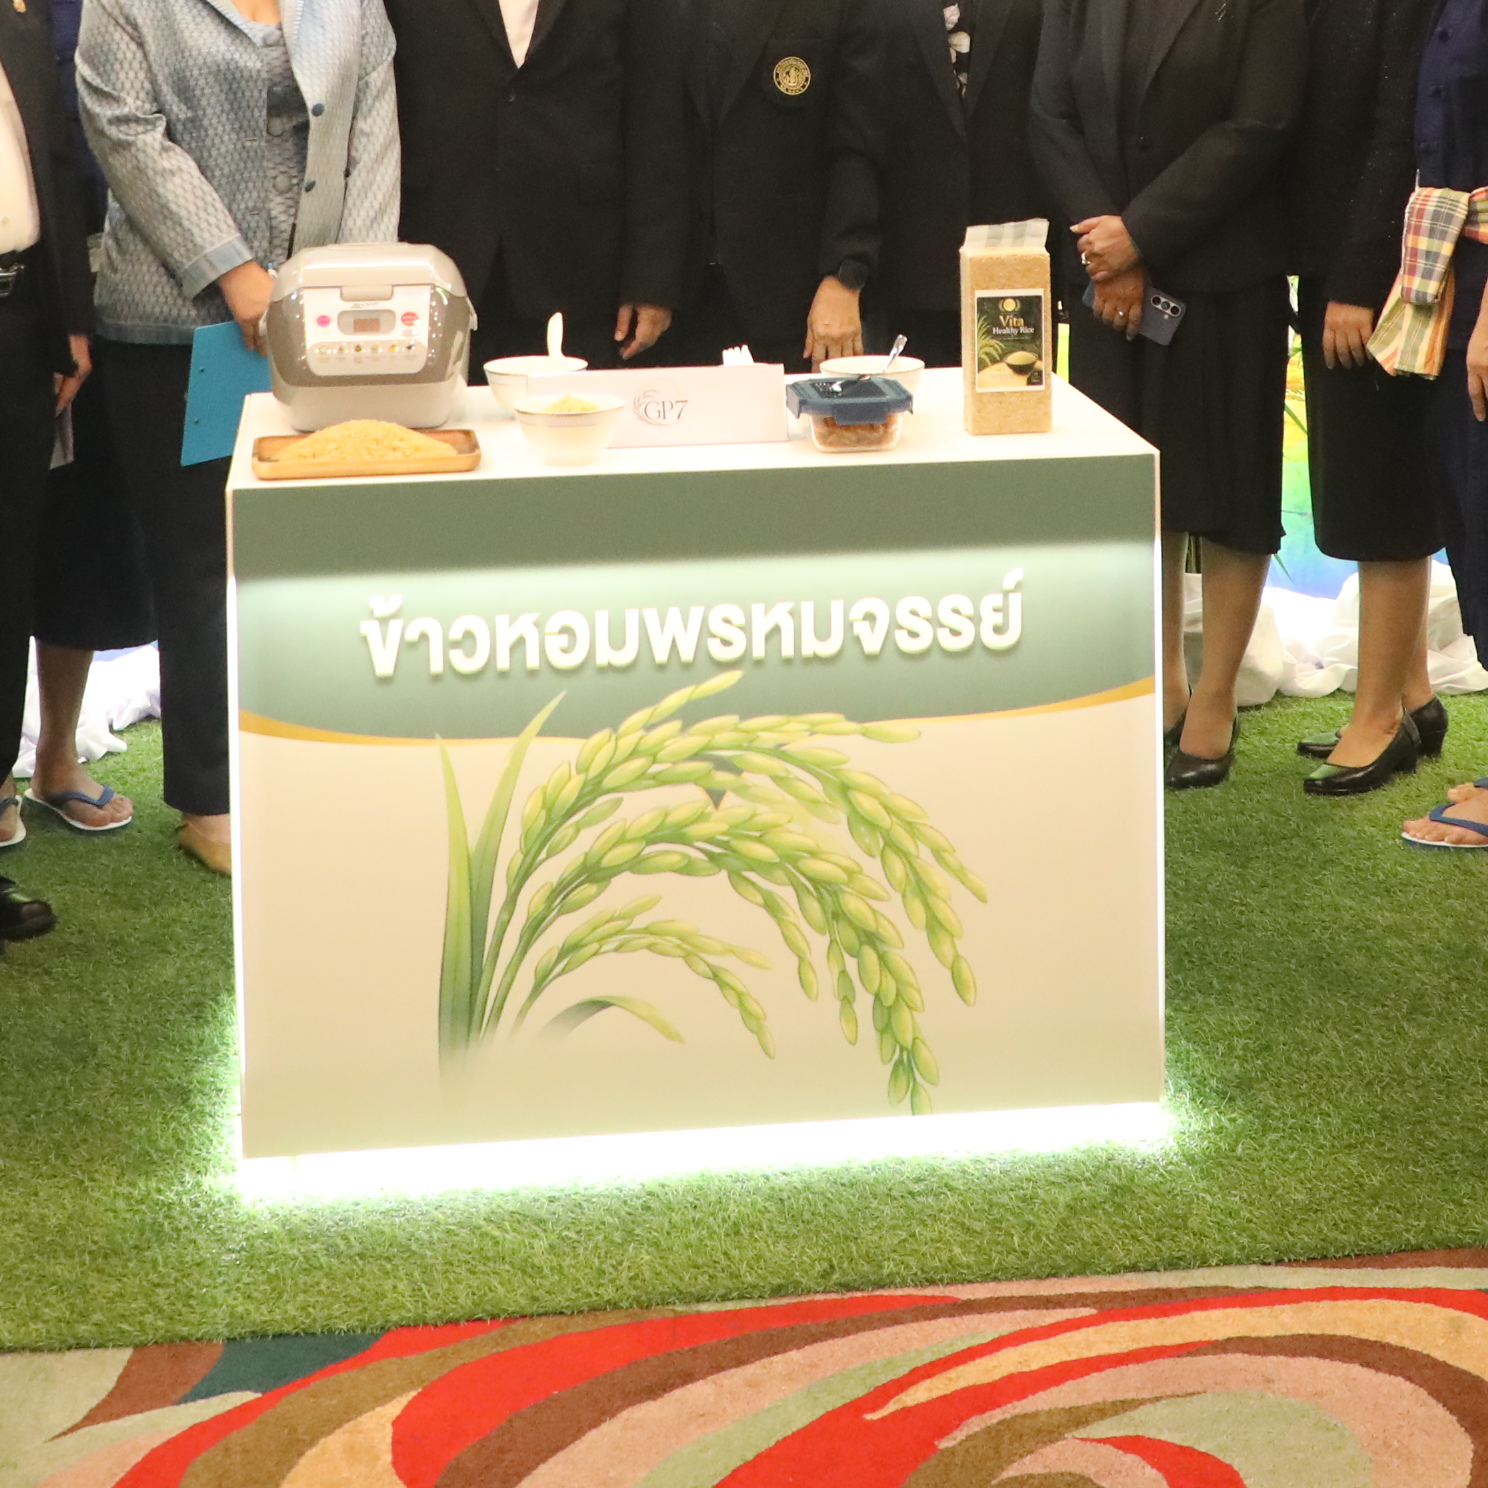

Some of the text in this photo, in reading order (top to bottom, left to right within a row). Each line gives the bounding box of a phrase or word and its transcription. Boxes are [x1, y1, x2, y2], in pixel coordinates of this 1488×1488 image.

[999, 314, 1025, 327] Vita
[992, 326, 1035, 336] Healthy Rice
[643, 399, 690, 421] GP7
[359, 568, 1025, 679] ข้าวหอมพรหมจรรย์
